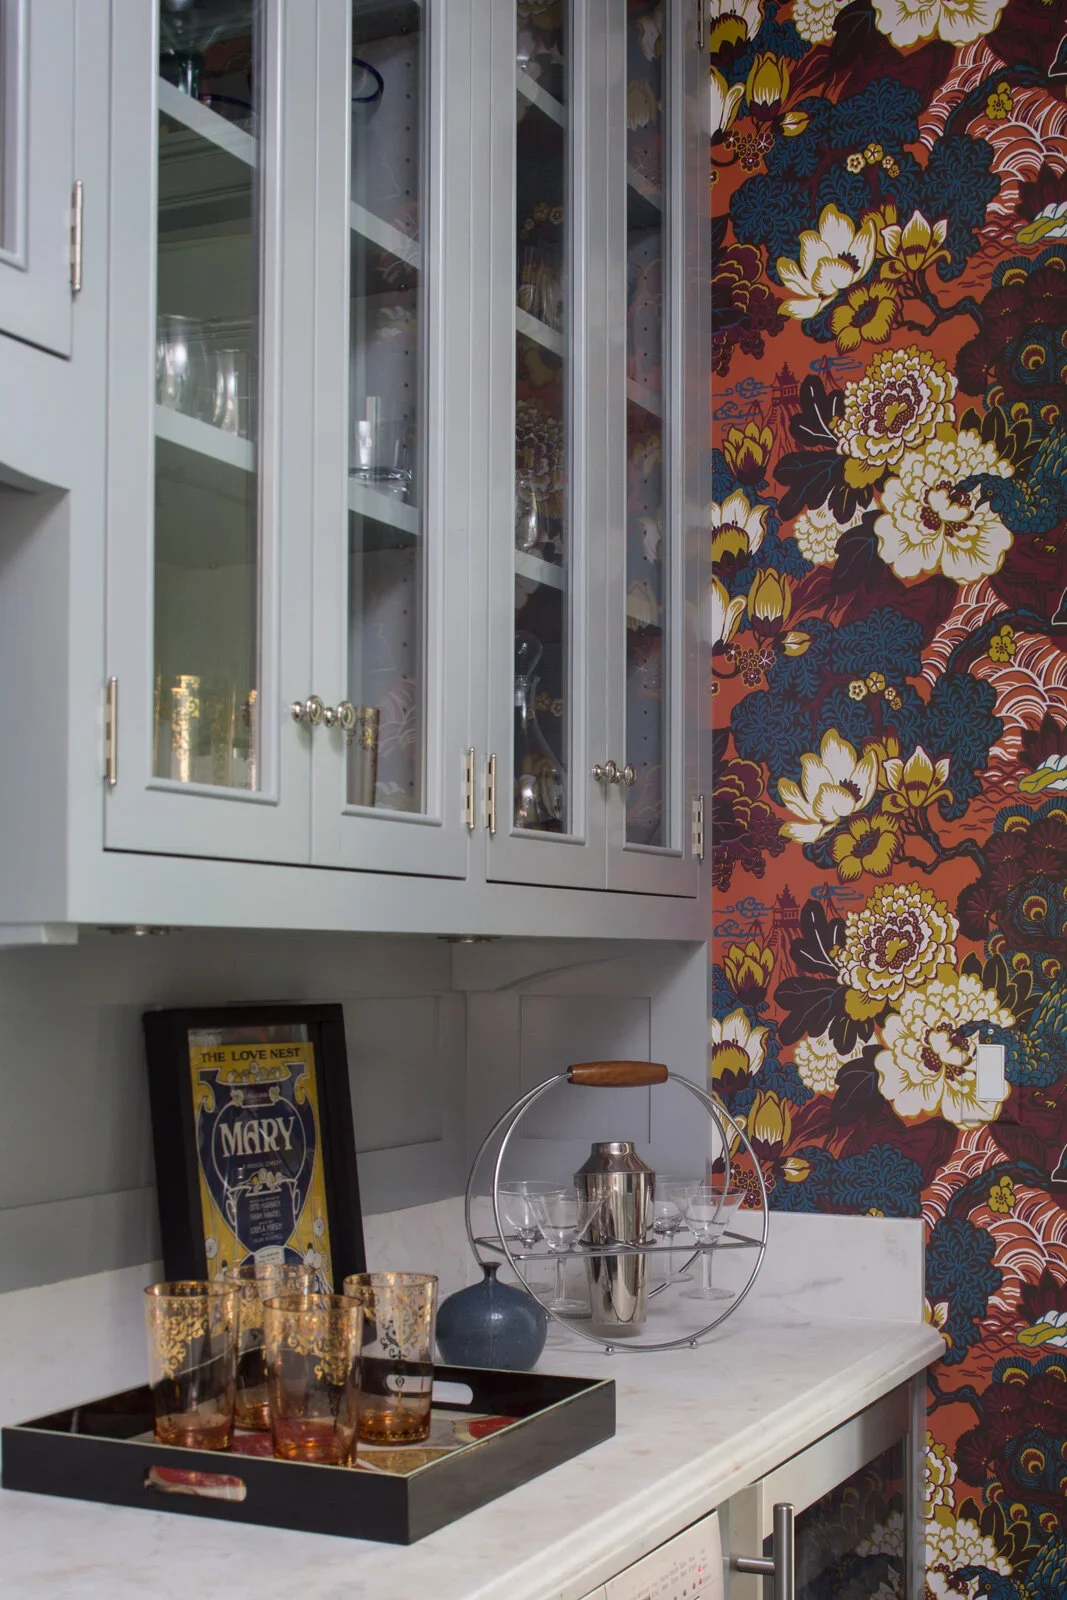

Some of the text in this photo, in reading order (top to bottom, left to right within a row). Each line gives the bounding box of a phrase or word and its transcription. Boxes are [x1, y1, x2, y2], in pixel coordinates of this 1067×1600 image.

[200, 1047, 301, 1063] THE LOVE NEST
[219, 1116, 296, 1158] MARY
